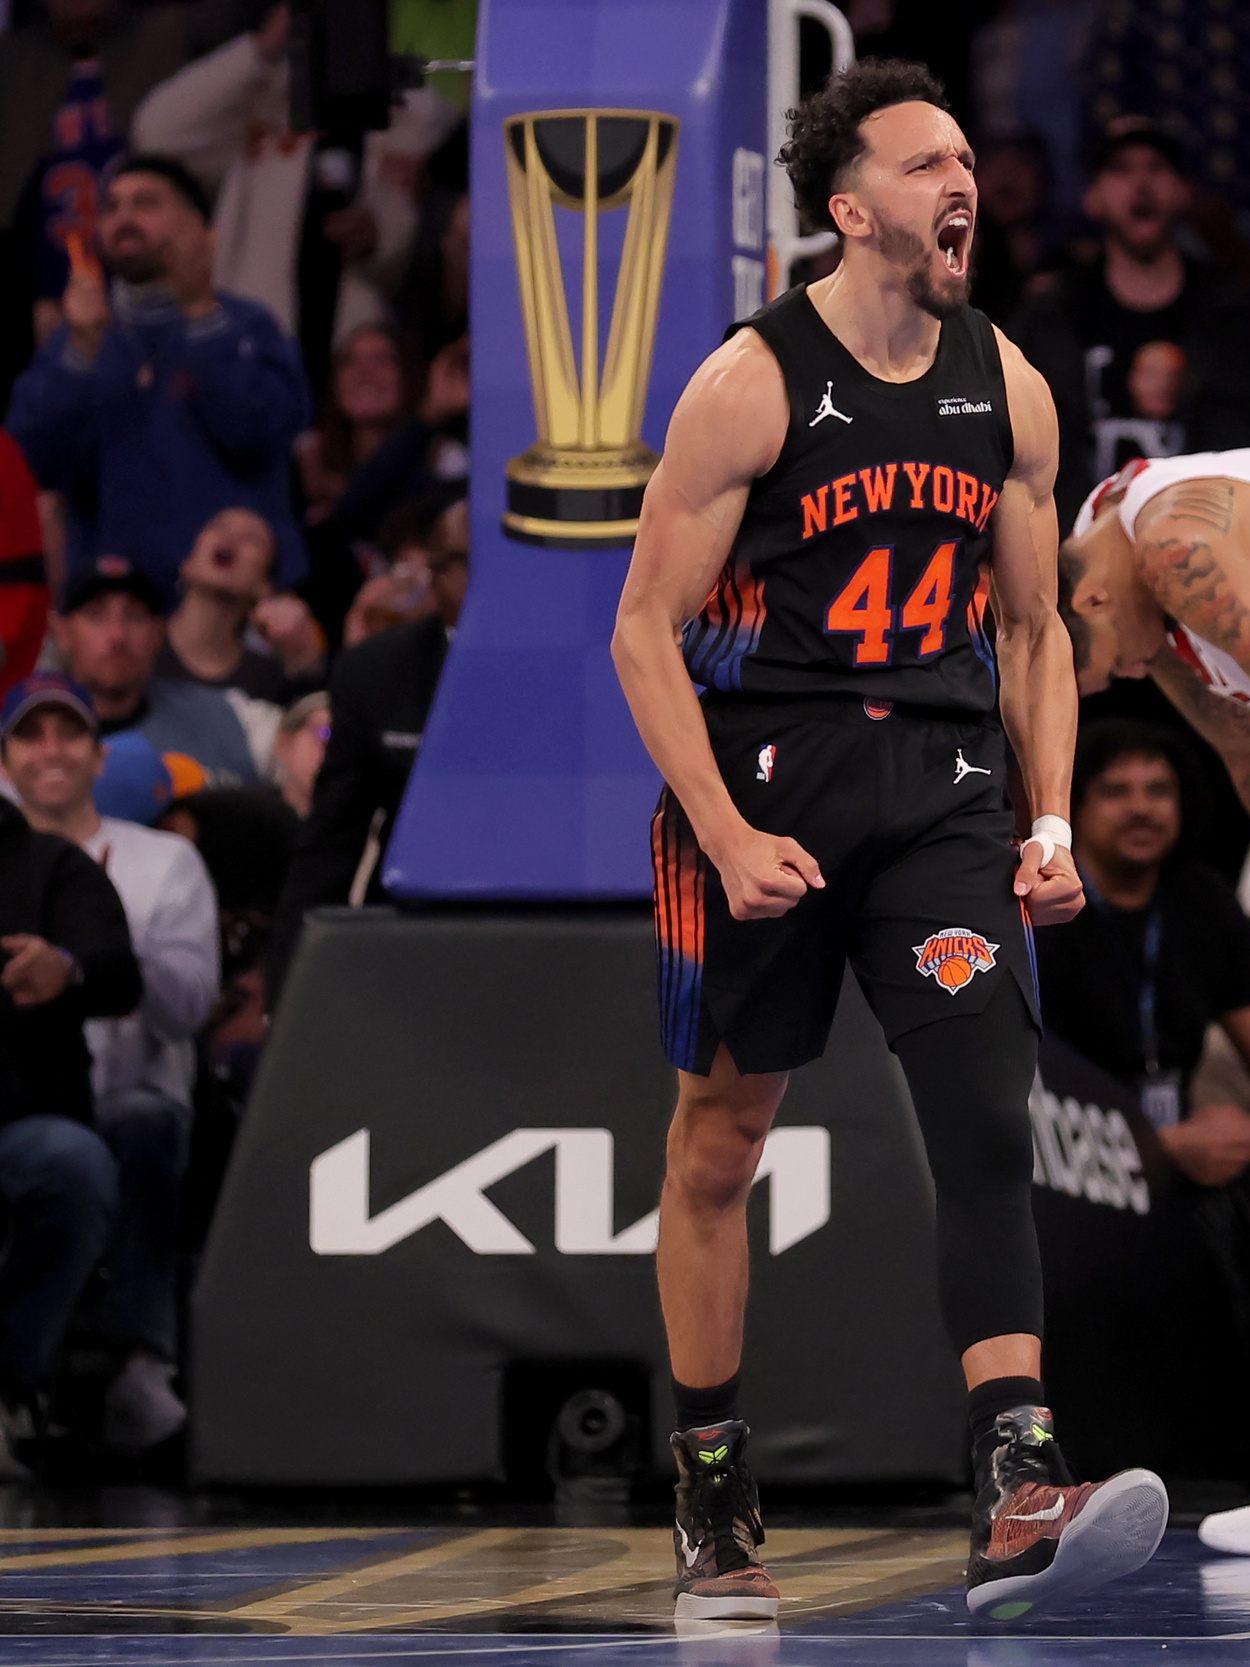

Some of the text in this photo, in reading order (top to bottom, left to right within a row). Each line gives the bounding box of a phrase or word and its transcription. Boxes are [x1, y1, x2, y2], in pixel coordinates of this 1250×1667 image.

[939, 400, 992, 416] abu dhabi
[800, 461, 999, 539] NEW YORK
[823, 537, 962, 667] 44
[919, 935, 993, 968] KNICKS
[940, 929, 971, 938] NEW YORK
[309, 1127, 831, 1255] KIA
